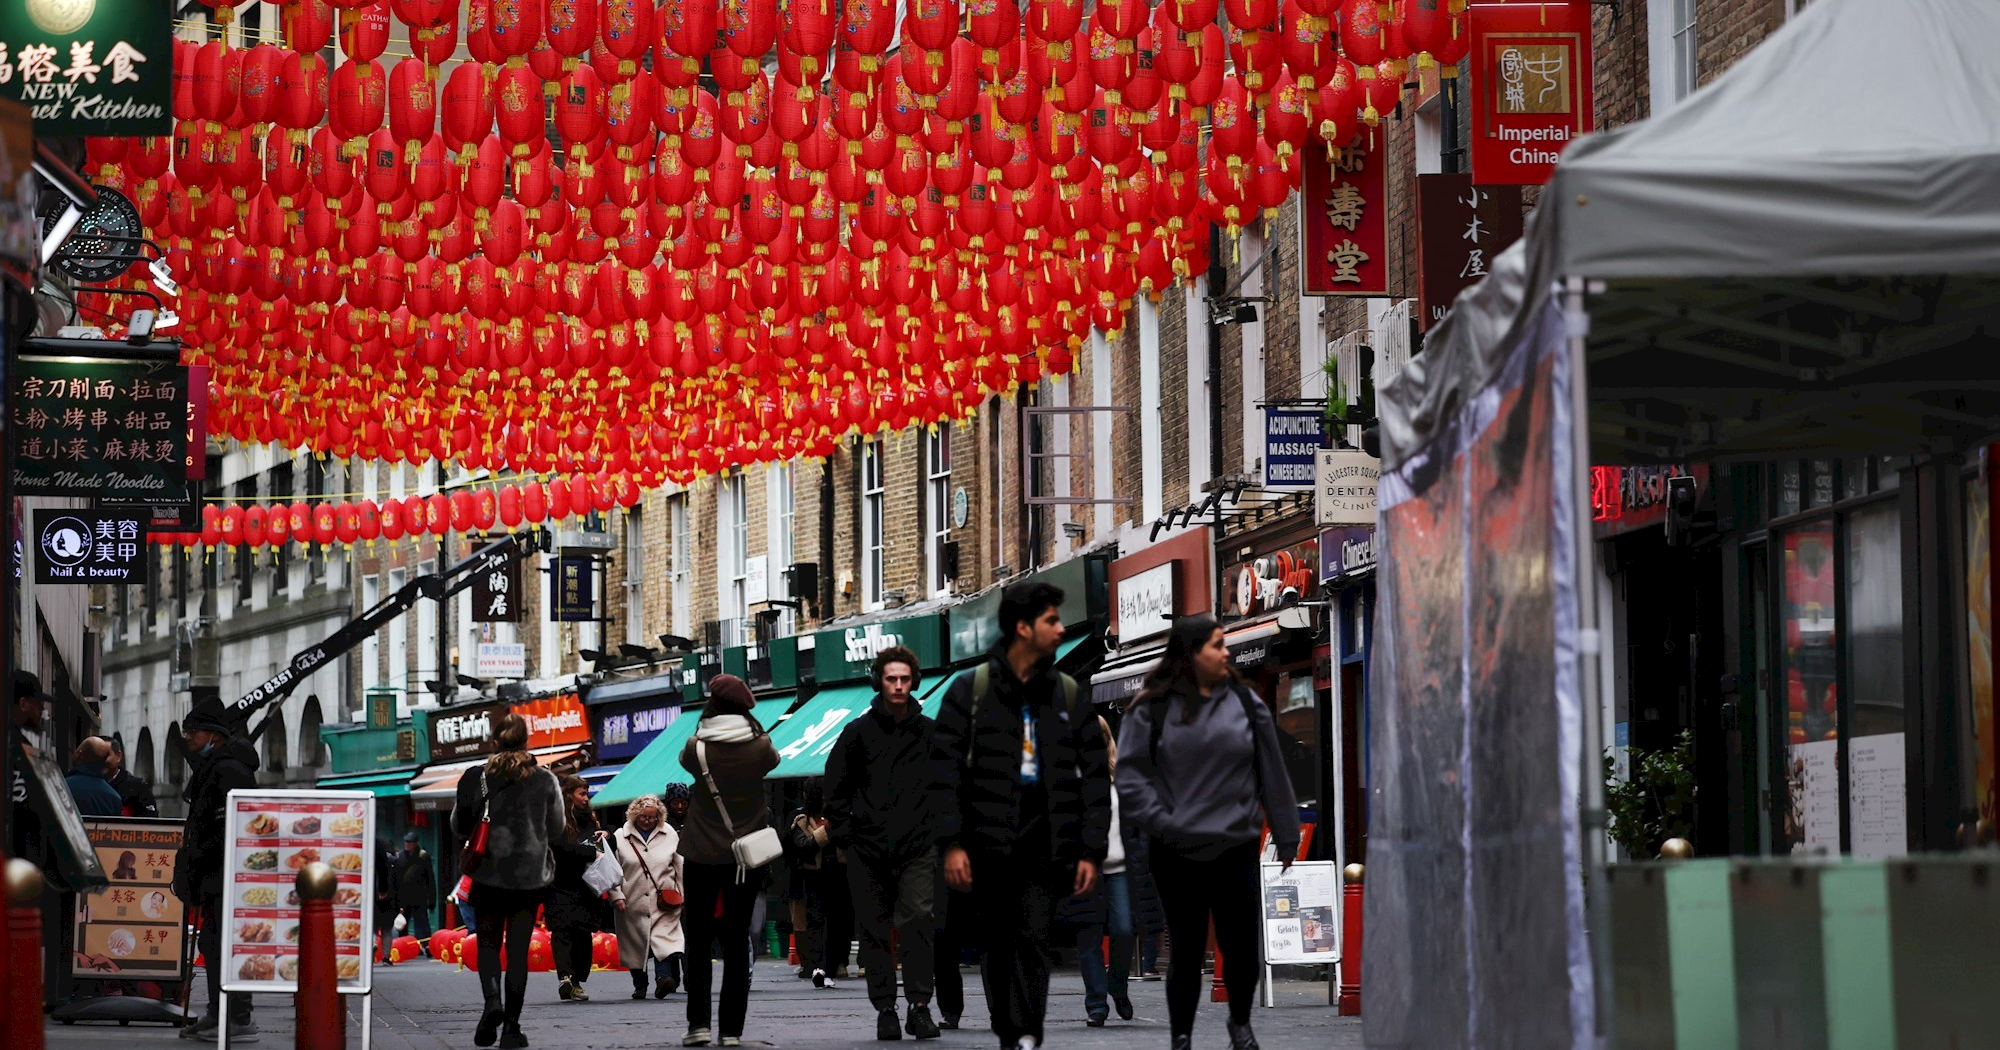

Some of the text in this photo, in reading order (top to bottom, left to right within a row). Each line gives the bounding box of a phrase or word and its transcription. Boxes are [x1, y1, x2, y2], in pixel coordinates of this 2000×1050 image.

[20, 83, 78, 99] NEW
[69, 93, 164, 120] Kitchen
[1499, 124, 1569, 144] Imperial
[1510, 148, 1559, 164] China
[119, 201, 138, 233] SALON
[1458, 186, 1490, 278] 小木屋
[14, 377, 176, 401] 宗刀削面、拉面
[1269, 416, 1320, 435] ACUPUNCTURE
[20, 438, 176, 463] 道小菜、麻辣烫
[54, 471, 103, 488] Made
[105, 471, 165, 490] Noodles
[1269, 464, 1293, 480] CHINESE
[1325, 466, 1359, 484] LEICESTER
[95, 519, 138, 540] 美容
[95, 542, 136, 562] 美甲
[1342, 538, 1370, 570] Chinese
[50, 567, 129, 579] Nail & beauty
[264, 670, 293, 694] 8351
[145, 853, 170, 866] 美发
[111, 889, 136, 903] 美容
[143, 929, 168, 943] 美甲
[1277, 925, 1299, 935] Gelato
